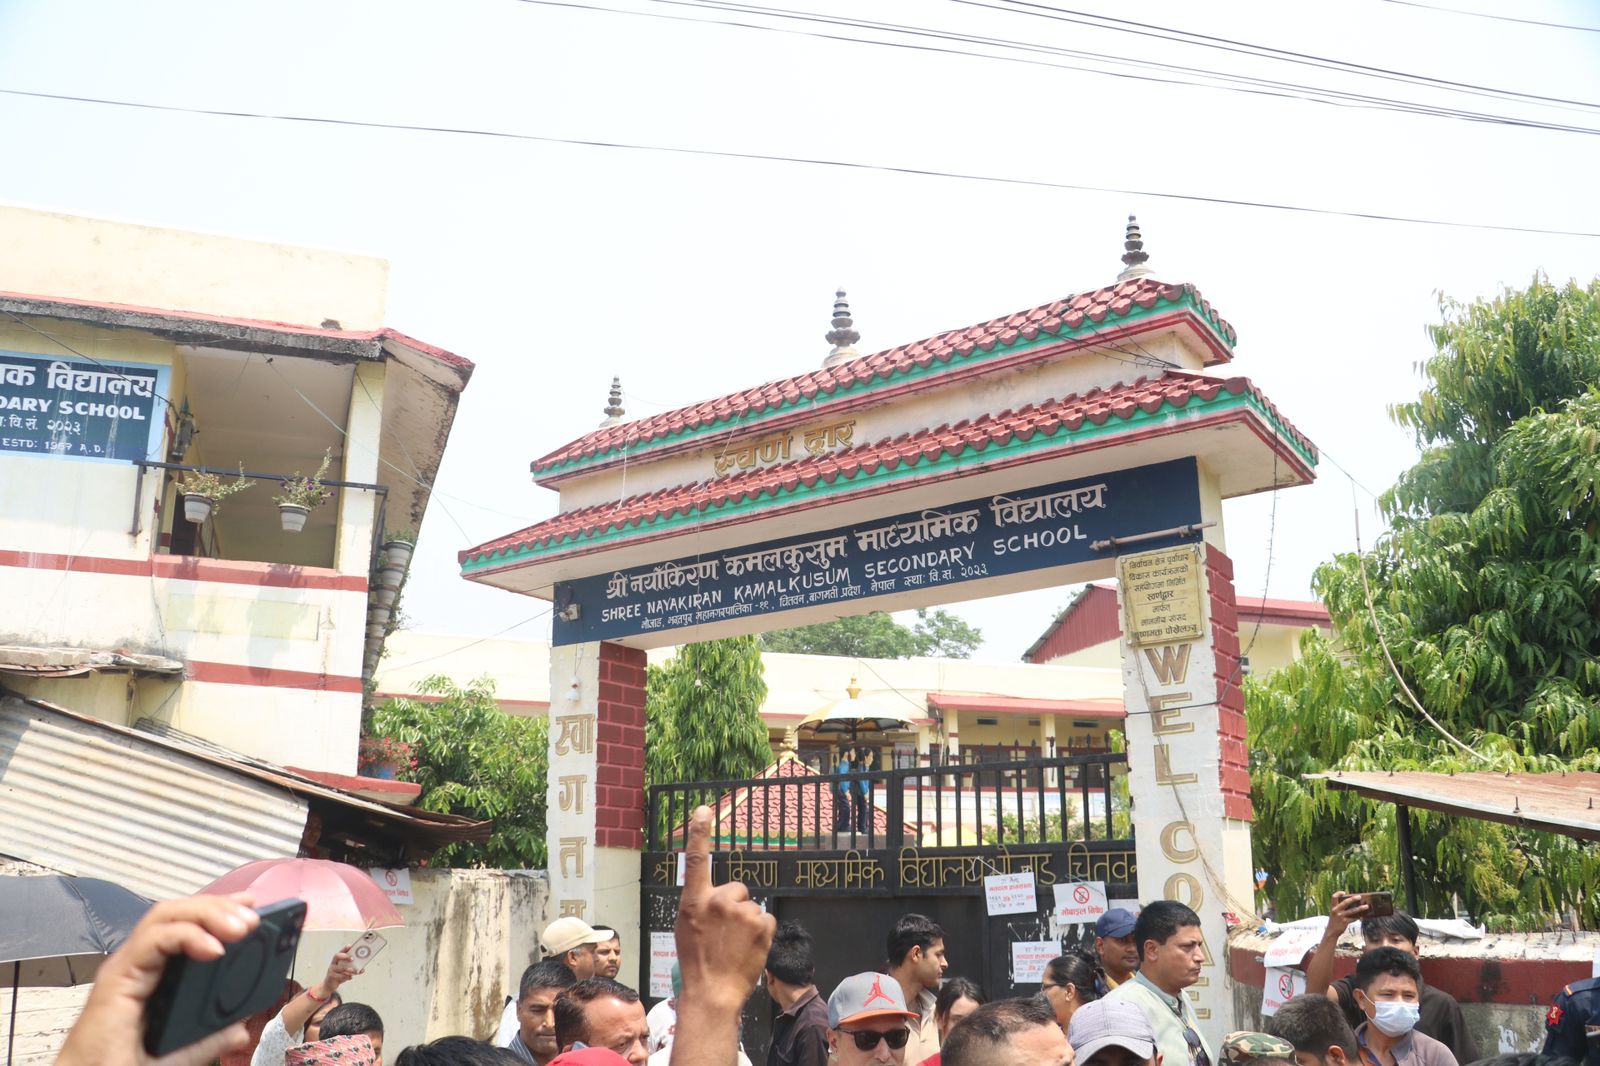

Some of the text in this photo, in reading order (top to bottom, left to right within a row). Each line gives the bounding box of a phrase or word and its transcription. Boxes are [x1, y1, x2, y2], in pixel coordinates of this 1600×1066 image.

[47, 361, 155, 398] विद्यालय
[47, 419, 81, 435] २०२३
[59, 401, 145, 420] SCHOOL
[2, 438, 38, 449] ESTD:
[714, 420, 856, 477] स्वर्ण द्वार
[606, 572, 629, 599] श्री
[722, 535, 848, 577] कमलकुसुम
[854, 509, 981, 552] माध्यमिक
[988, 483, 1108, 528] विद्यालय
[601, 604, 641, 622] SHREE
[647, 590, 722, 615] NAYAKIRAN
[865, 541, 975, 578] SECONDARY
[993, 524, 1087, 555] SCHOOL
[871, 578, 896, 592] नेपाल
[961, 563, 989, 578] २०२३
[1144, 643, 1215, 1019] WELCO
[653, 852, 677, 886] श्री
[795, 850, 884, 888] माध्यमिक
[898, 847, 984, 887] विद्यालय
